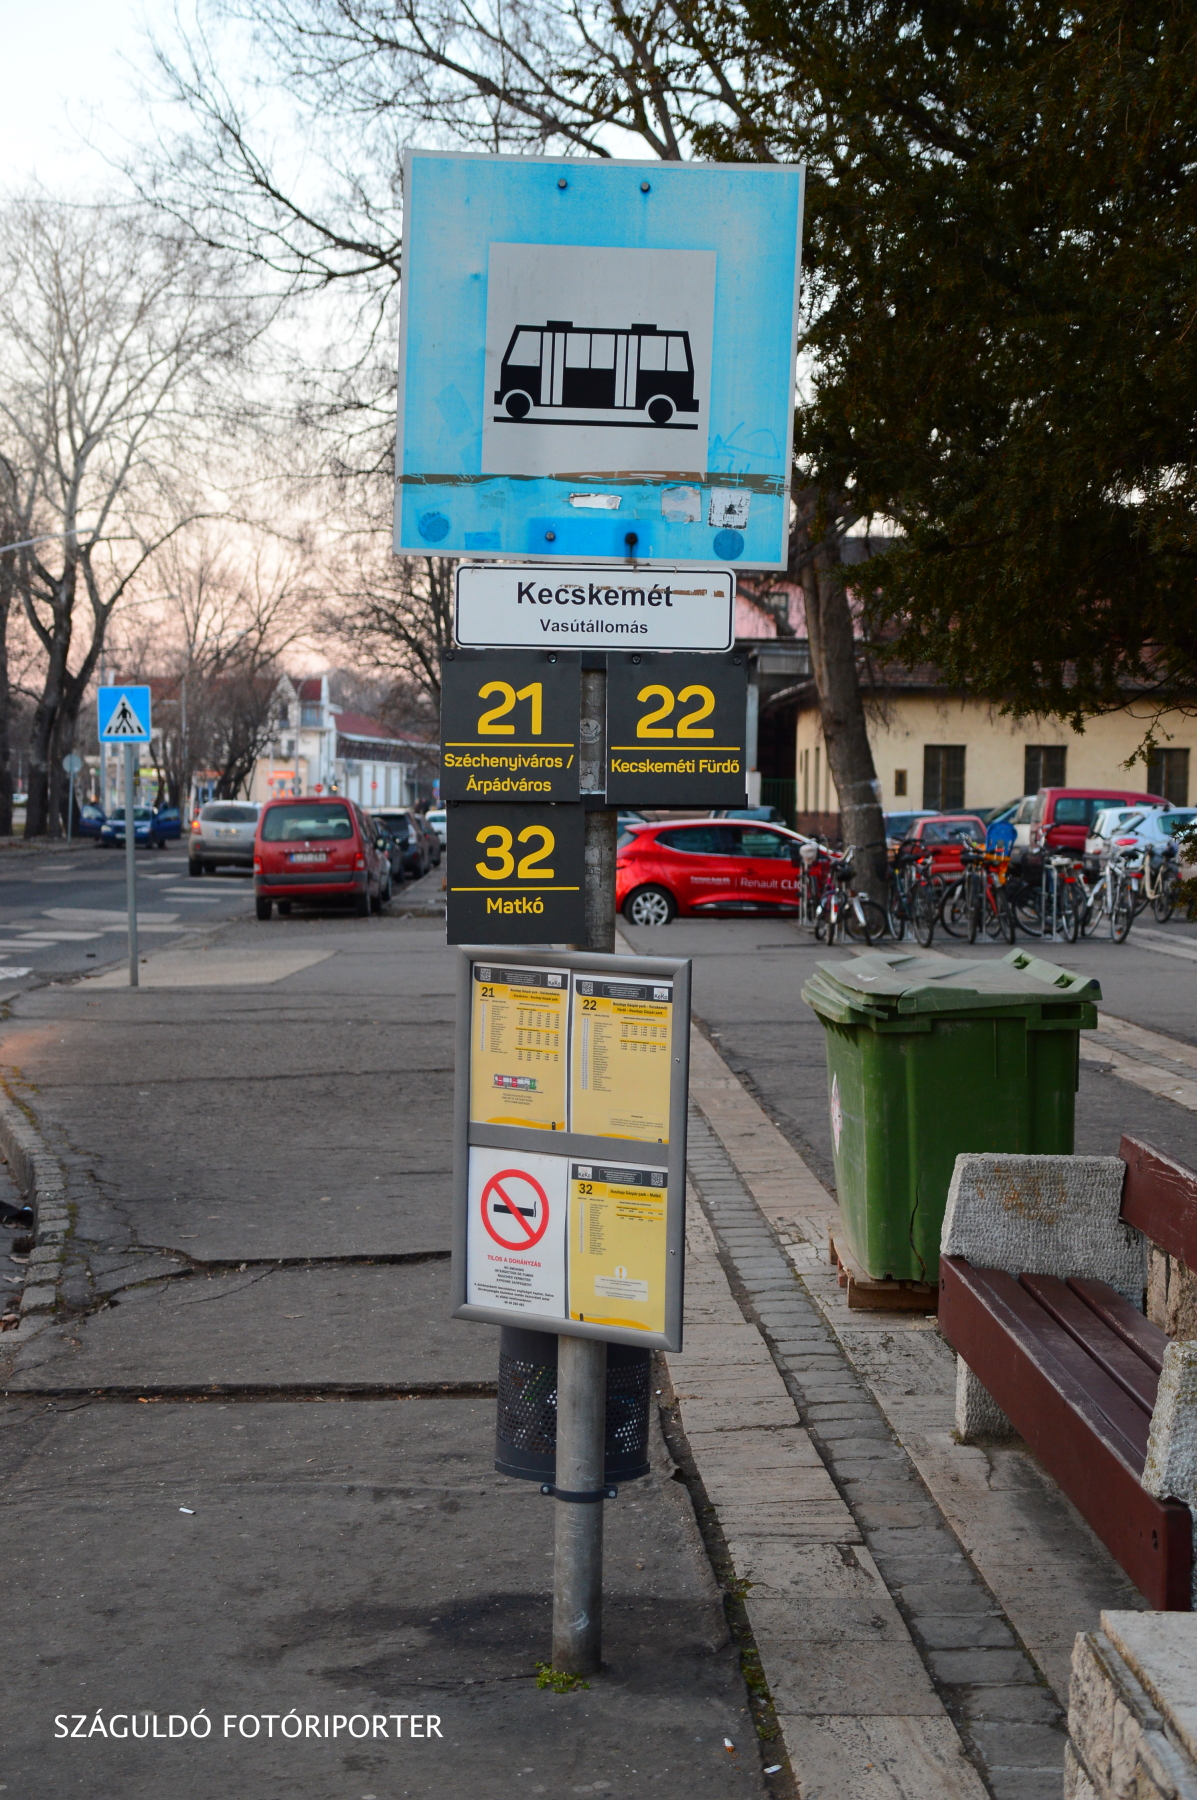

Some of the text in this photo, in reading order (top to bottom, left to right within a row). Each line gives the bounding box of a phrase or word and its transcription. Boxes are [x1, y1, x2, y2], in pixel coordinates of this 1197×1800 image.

[517, 581, 674, 607] Kecskemét
[540, 619, 648, 634] Vasútállomás
[477, 681, 543, 735] 21
[636, 684, 716, 738] 22
[444, 753, 575, 772] Széchenyiváros /
[610, 758, 741, 774] Kecskeméti Fürdő
[466, 774, 552, 795] Árpádváros
[475, 825, 556, 880] 32
[740, 877, 778, 888] Renault
[486, 896, 545, 915] Matkó
[481, 986, 495, 998] 21
[582, 999, 597, 1011] 22
[578, 1183, 593, 1195] 32
[487, 1254, 503, 1262] TILOS
[508, 1257, 542, 1268] DOHÁNYZÁS
